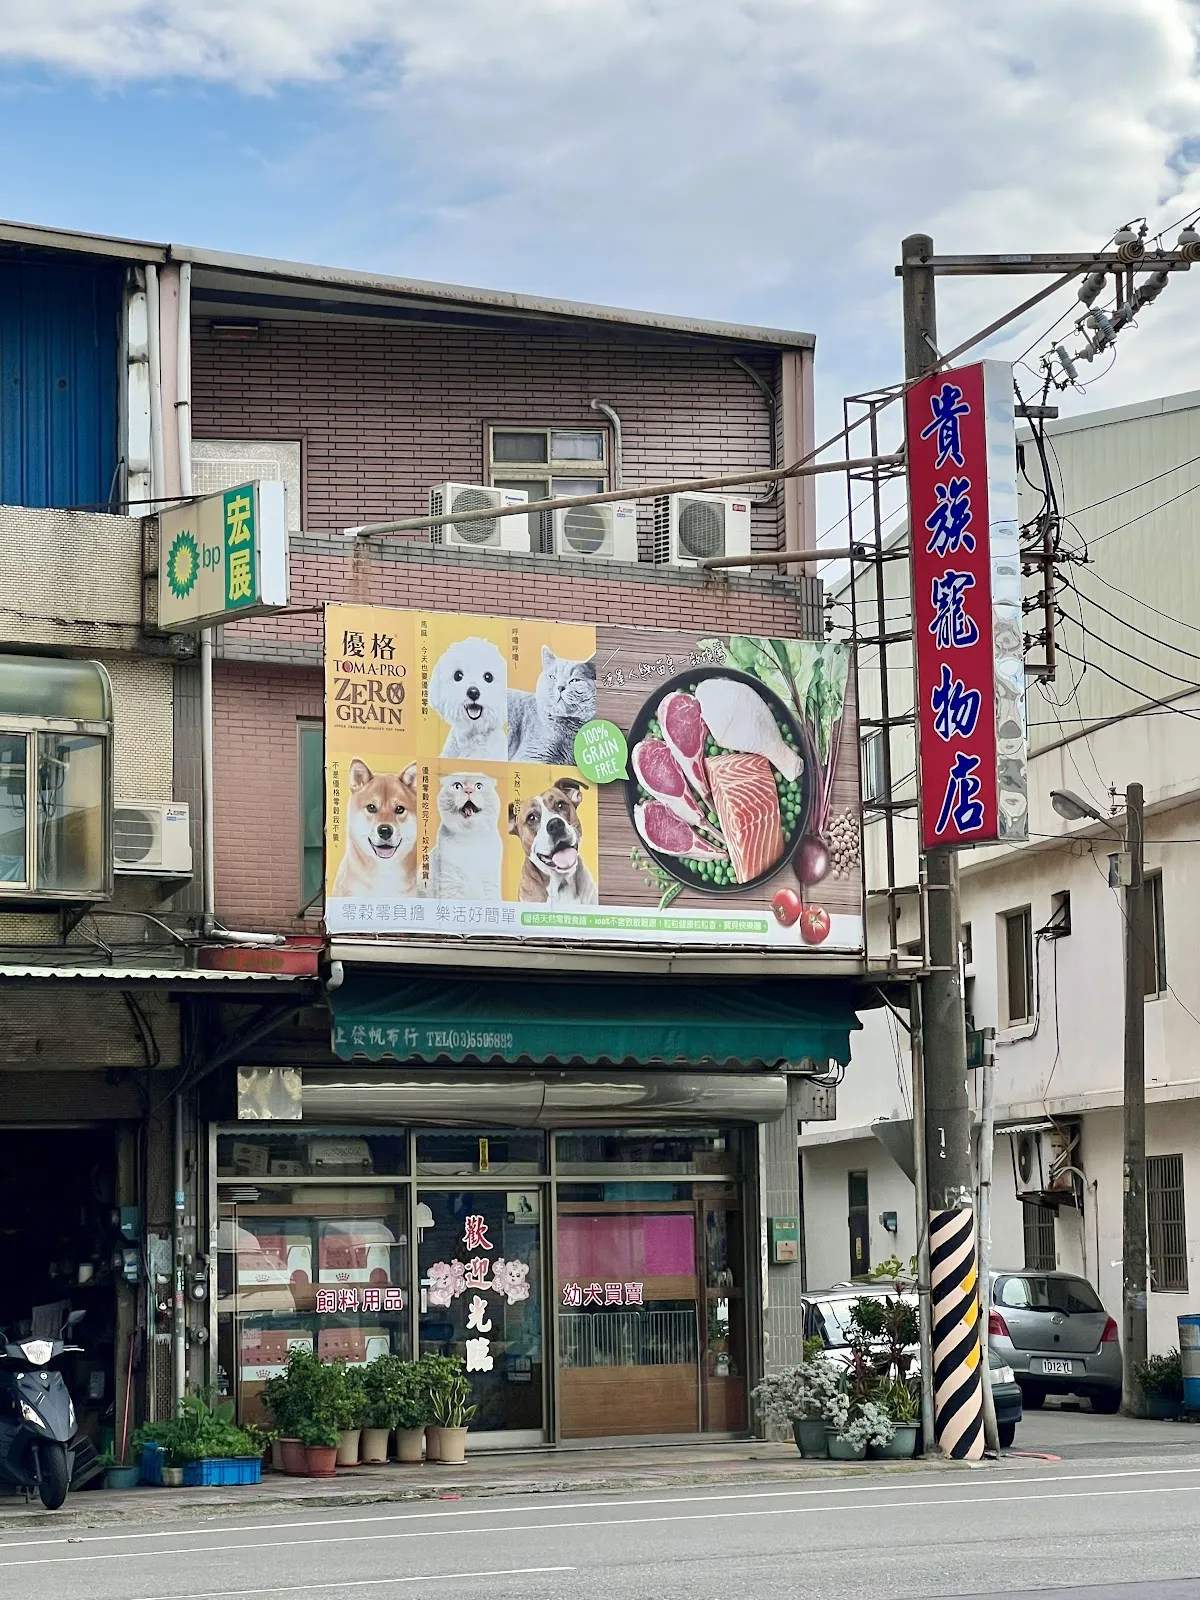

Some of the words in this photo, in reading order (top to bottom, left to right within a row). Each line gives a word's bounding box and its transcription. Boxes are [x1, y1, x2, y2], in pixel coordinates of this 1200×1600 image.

[202, 543, 221, 572] bp
[226, 494, 252, 601] 宏展
[919, 382, 986, 835] 貴族寵物店
[341, 630, 397, 661] 優格
[332, 659, 407, 678] TOMA-PRO
[333, 678, 406, 705] ZERO
[335, 703, 403, 725] GRAIN
[582, 723, 609, 746] 100%
[582, 737, 620, 765] GRAIN
[594, 757, 620, 780] FREE
[341, 903, 425, 921] 零穀零負擔
[436, 904, 516, 925] 樂活好簡單
[316, 1287, 404, 1314] 飼料用品
[462, 1214, 494, 1373] 歡迎光臨
[562, 1281, 644, 1307] 幼犬買賣
